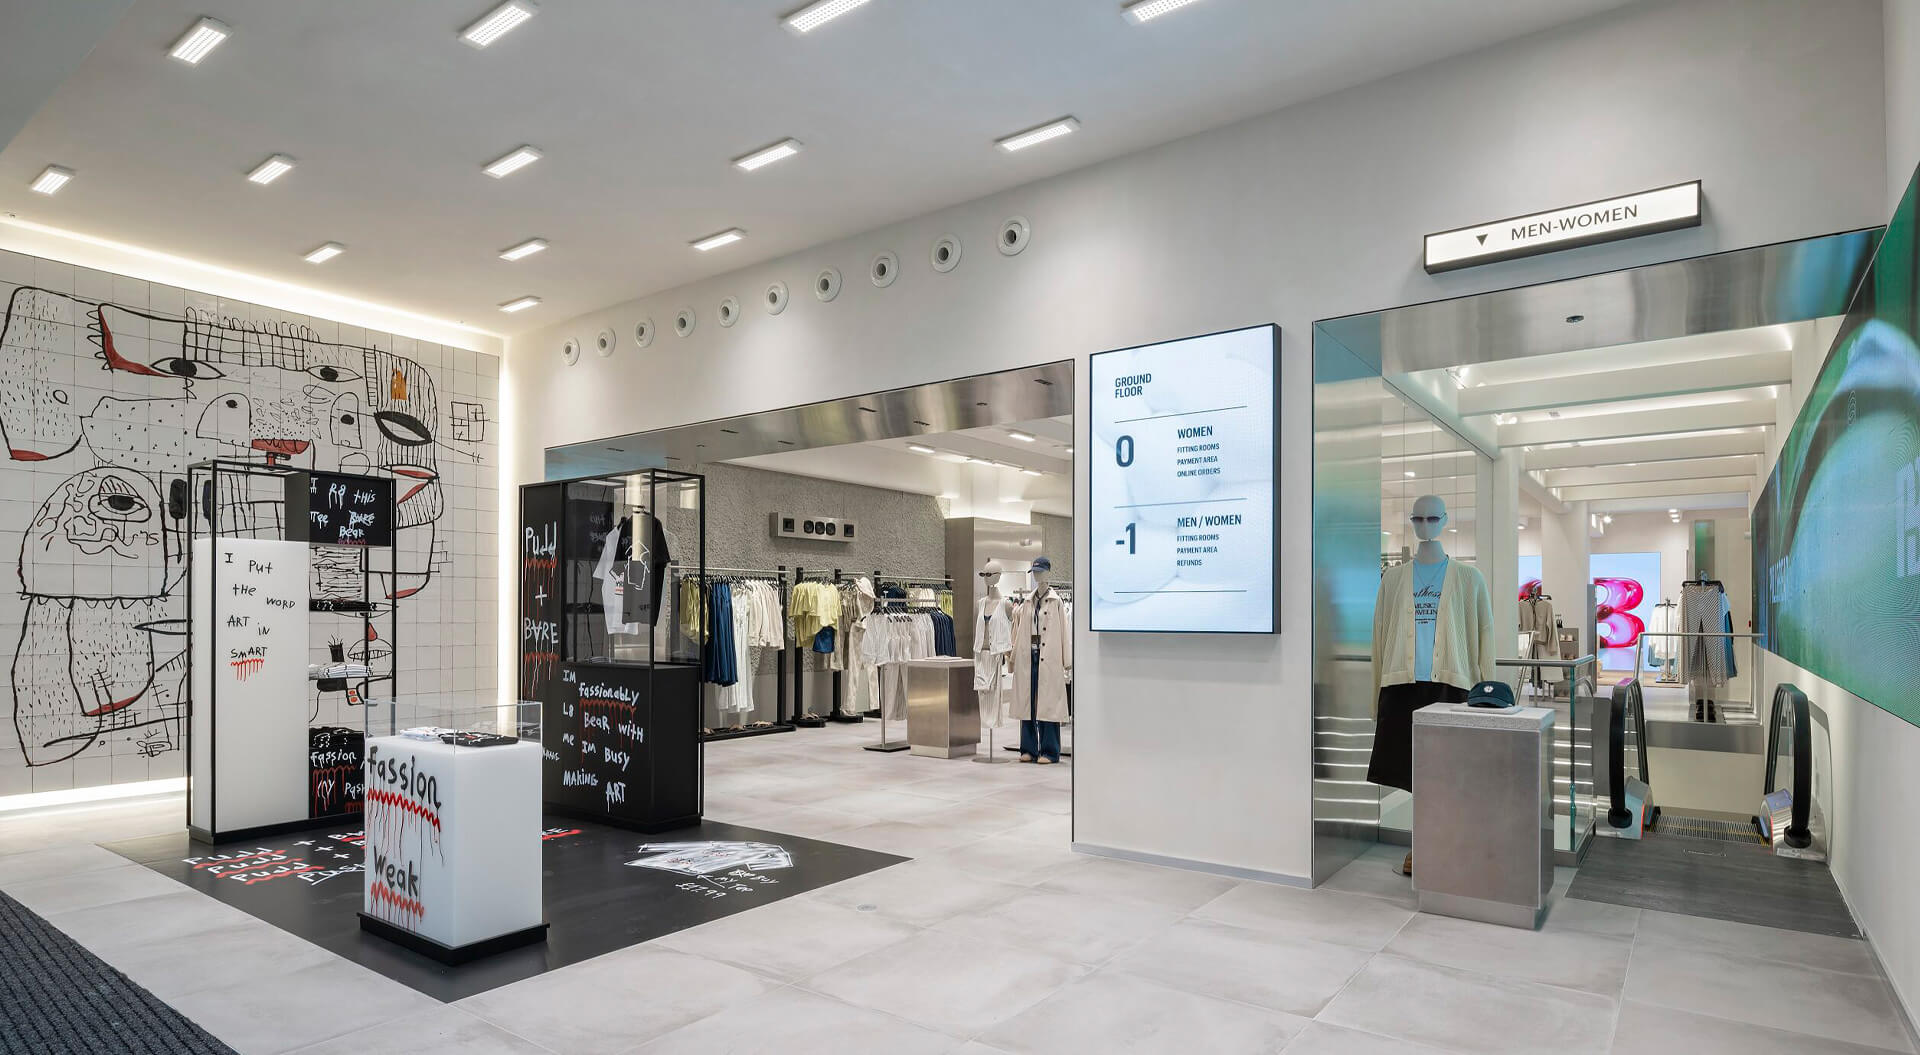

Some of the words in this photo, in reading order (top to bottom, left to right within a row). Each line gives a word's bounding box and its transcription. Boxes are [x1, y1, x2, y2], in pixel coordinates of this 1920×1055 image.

[1511, 204, 1638, 241] MEN-WOMEN
[1115, 373, 1152, 388] GROUND
[1115, 385, 1143, 399] FLOOR
[1177, 425, 1213, 439] WOMEN
[1115, 434, 1135, 468] 0
[1177, 444, 1198, 453] FITTING
[1199, 443, 1220, 452] ROOMS
[1177, 457, 1201, 466] PAYMENT
[1202, 455, 1218, 464] AREA
[1177, 469, 1197, 478] ONLINE
[1198, 467, 1221, 476] ORDERS
[1177, 517, 1197, 528] MEN
[1198, 515, 1204, 529] /
[1204, 514, 1242, 527] WOMEN
[1115, 522, 1136, 555] -1
[1177, 534, 1198, 543] FITTING
[1199, 533, 1219, 542] ROOMS
[1177, 546, 1201, 555] PAYMENT
[1202, 545, 1218, 554] AREA
[224, 552, 234, 563] I
[1177, 559, 1203, 567] REFUNDS
[227, 614, 251, 627] ART
[606, 781, 627, 806] ART
